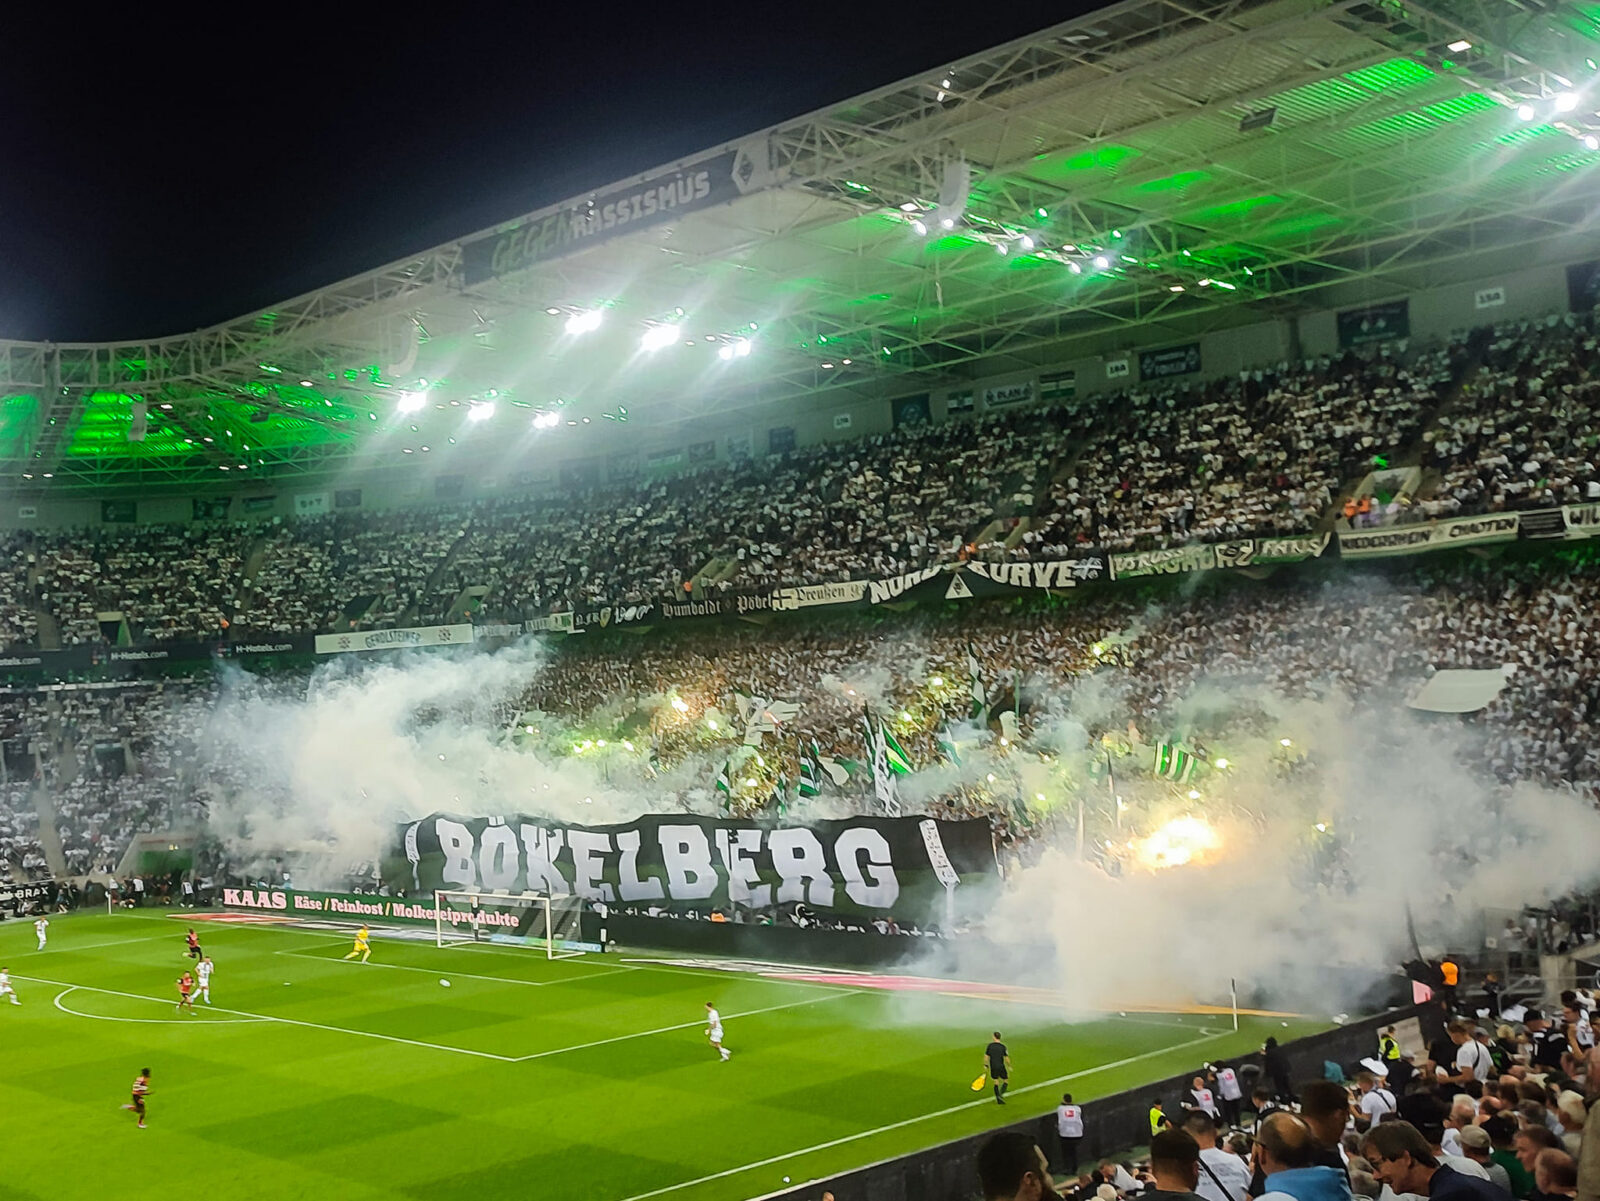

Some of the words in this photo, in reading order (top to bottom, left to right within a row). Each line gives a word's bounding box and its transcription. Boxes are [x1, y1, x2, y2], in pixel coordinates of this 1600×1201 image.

[570, 171, 710, 240] RASSISMUS
[435, 814, 900, 909] BÖKELBERG
[223, 888, 287, 909] KAAS
